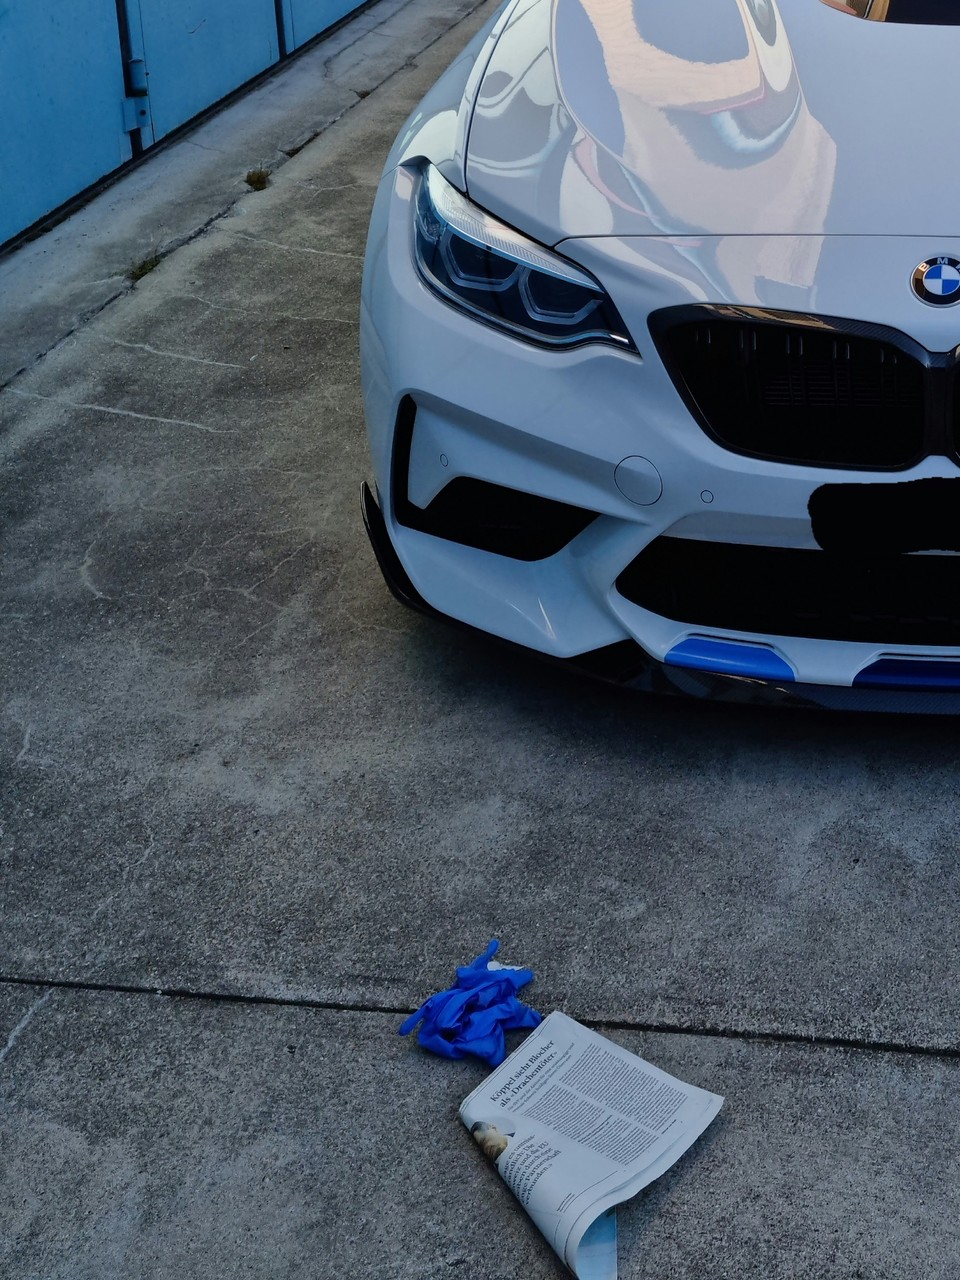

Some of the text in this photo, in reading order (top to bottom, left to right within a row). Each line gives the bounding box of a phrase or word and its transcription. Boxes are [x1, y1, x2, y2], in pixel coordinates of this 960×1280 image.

[490, 1076, 516, 1102] Köppel
[514, 1062, 532, 1080] sieht
[528, 1040, 554, 1065] Blocher
[500, 1096, 511, 1108] als
